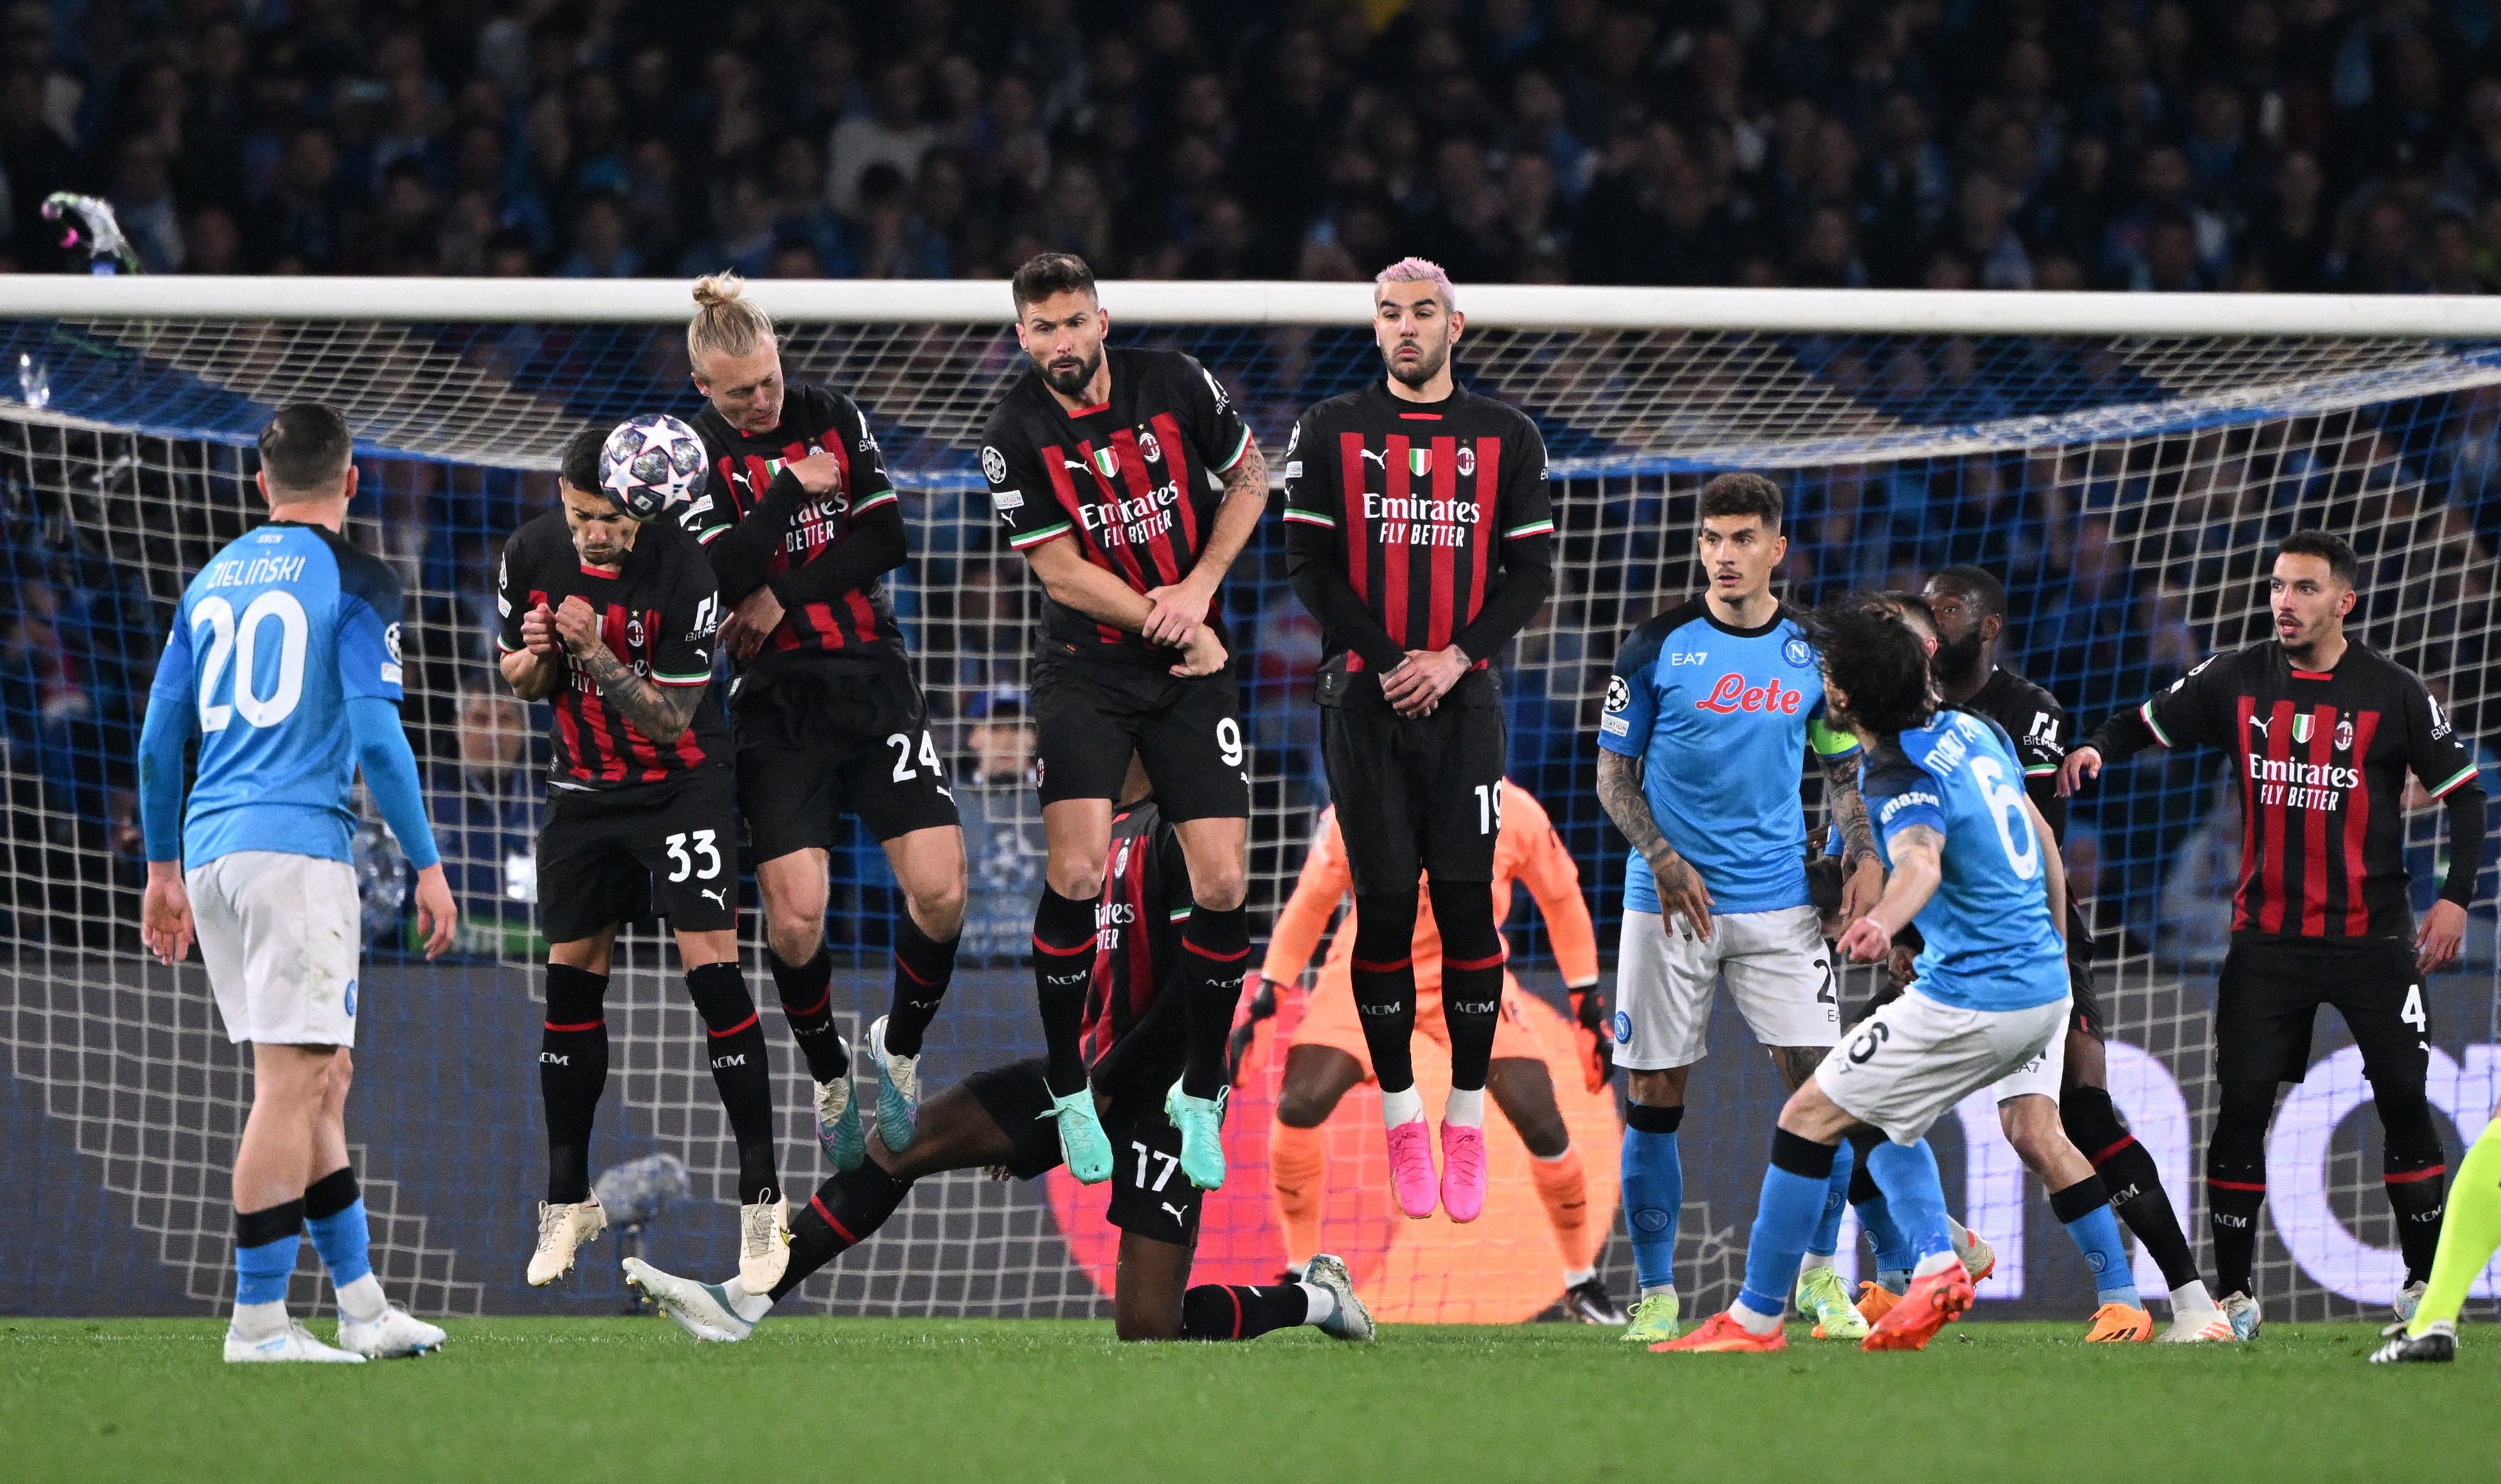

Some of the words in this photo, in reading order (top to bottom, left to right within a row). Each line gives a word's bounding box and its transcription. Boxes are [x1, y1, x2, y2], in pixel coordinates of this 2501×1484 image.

[1078, 480, 1178, 531] Emirates
[1363, 492, 1480, 524] Emirates
[786, 520, 835, 553] BETTER
[1104, 524, 1126, 548] FLY
[1128, 509, 1172, 544] BETTER
[1380, 522, 1407, 543] FLY
[1410, 523, 1464, 547] BETTER
[206, 551, 307, 589] ZIELIŃSKI
[685, 621, 717, 642] BitME
[190, 590, 309, 733] 20
[1672, 652, 1708, 666] EA7
[1790, 644, 1805, 659] N
[571, 672, 590, 694] FLY
[1696, 672, 1802, 715] Lete
[887, 730, 942, 783] 24
[1217, 717, 1242, 766] 9
[2023, 734, 2064, 756] BitMEX
[2248, 753, 2358, 789] Emirates
[1880, 792, 1940, 825] amazon
[2260, 785, 2283, 805] FLY
[2287, 786, 2339, 811] BETTER
[1969, 756, 2037, 880] 6
[665, 829, 721, 882] 33
[1047, 970, 1086, 985] ACM
[1361, 1001, 1401, 1015] ACM
[1454, 1001, 1495, 1014] ACM
[2401, 984, 2426, 1032] 4
[1849, 1022, 1889, 1064] 6
[712, 1054, 746, 1069] ACM
[1131, 1140, 1179, 1192] 17
[2214, 1213, 2247, 1228] ACM
[2411, 1204, 2442, 1222] ACM
